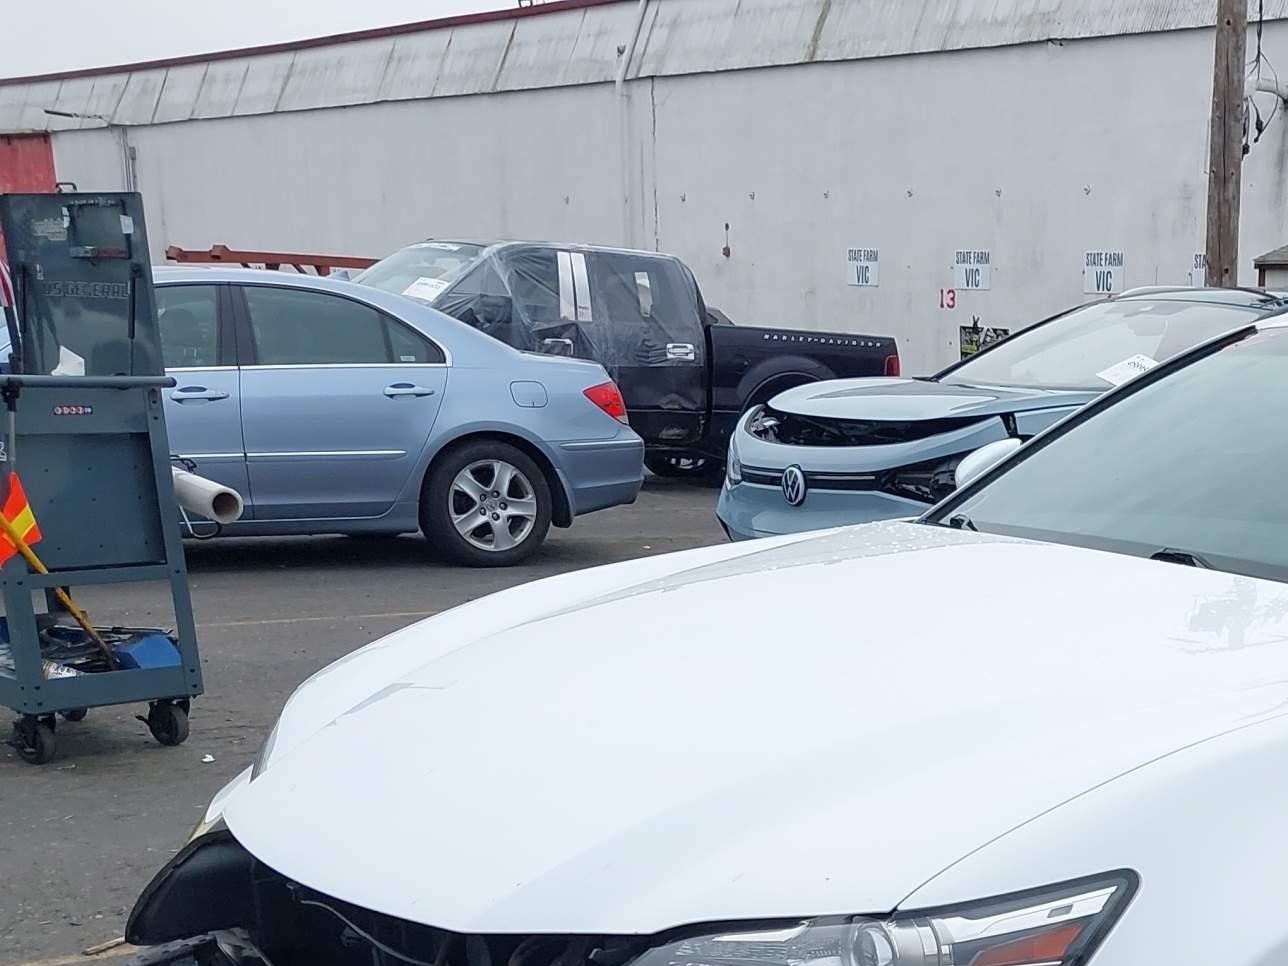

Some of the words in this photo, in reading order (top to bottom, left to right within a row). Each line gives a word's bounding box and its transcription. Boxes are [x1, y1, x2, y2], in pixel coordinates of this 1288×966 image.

[848, 249, 862, 262] STATE
[863, 250, 878, 262] FARM
[956, 251, 972, 264] STATE
[973, 251, 990, 265] FARM
[1085, 252, 1103, 267] STATE
[1104, 252, 1124, 267] FARM
[1194, 254, 1206, 269] STA
[856, 265, 869, 284] VIC
[965, 268, 980, 288] VIC
[1095, 270, 1112, 292] VIC
[939, 288, 956, 309] 13
